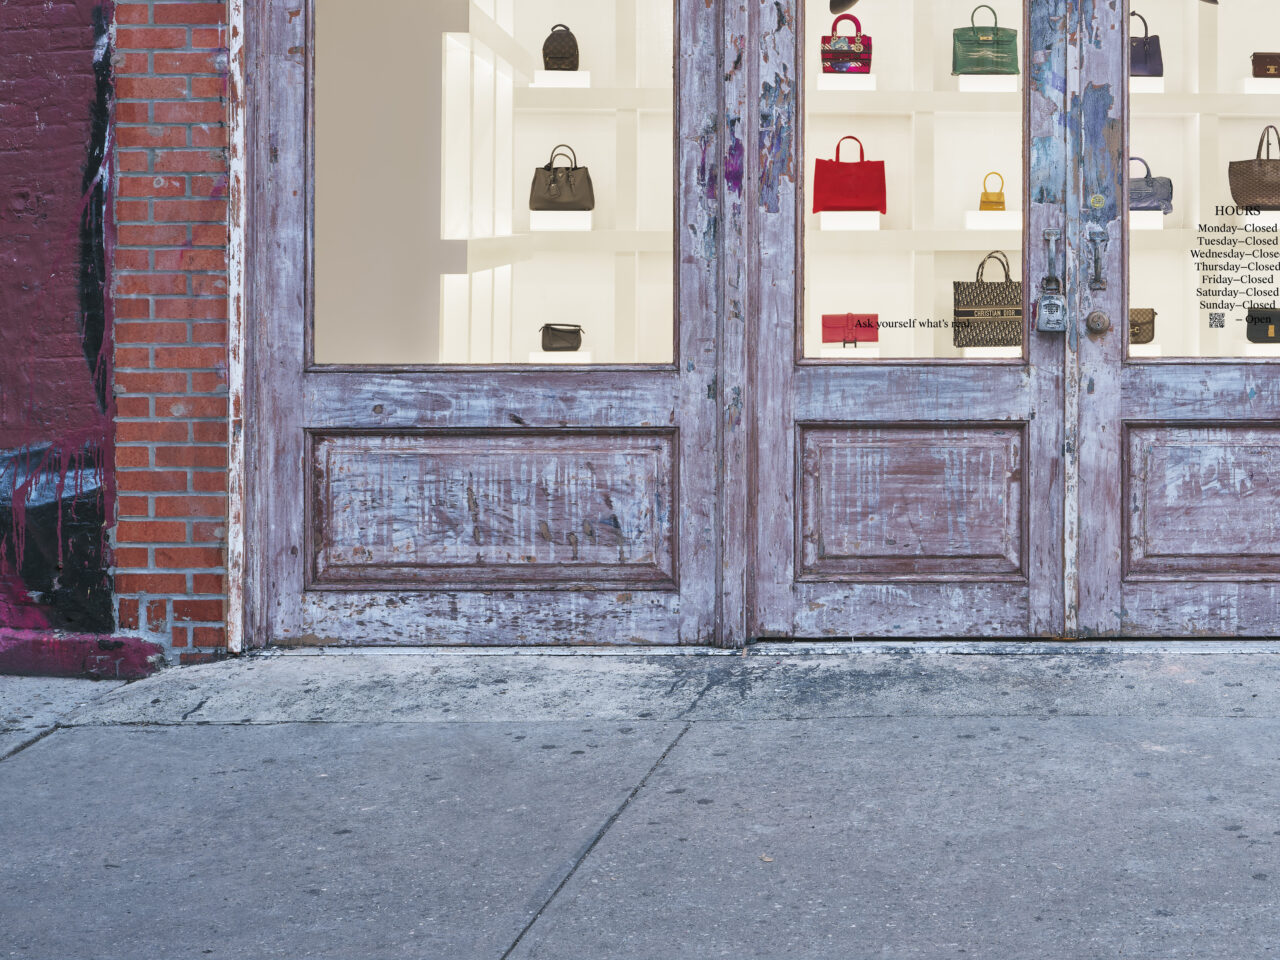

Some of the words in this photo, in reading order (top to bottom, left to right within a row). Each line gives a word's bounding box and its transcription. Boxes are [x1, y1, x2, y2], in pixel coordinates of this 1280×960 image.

[1215, 206, 1261, 215] HOURS
[1246, 315, 1271, 324] Open
[855, 319, 874, 328] Ask
[876, 319, 917, 330] yourself
